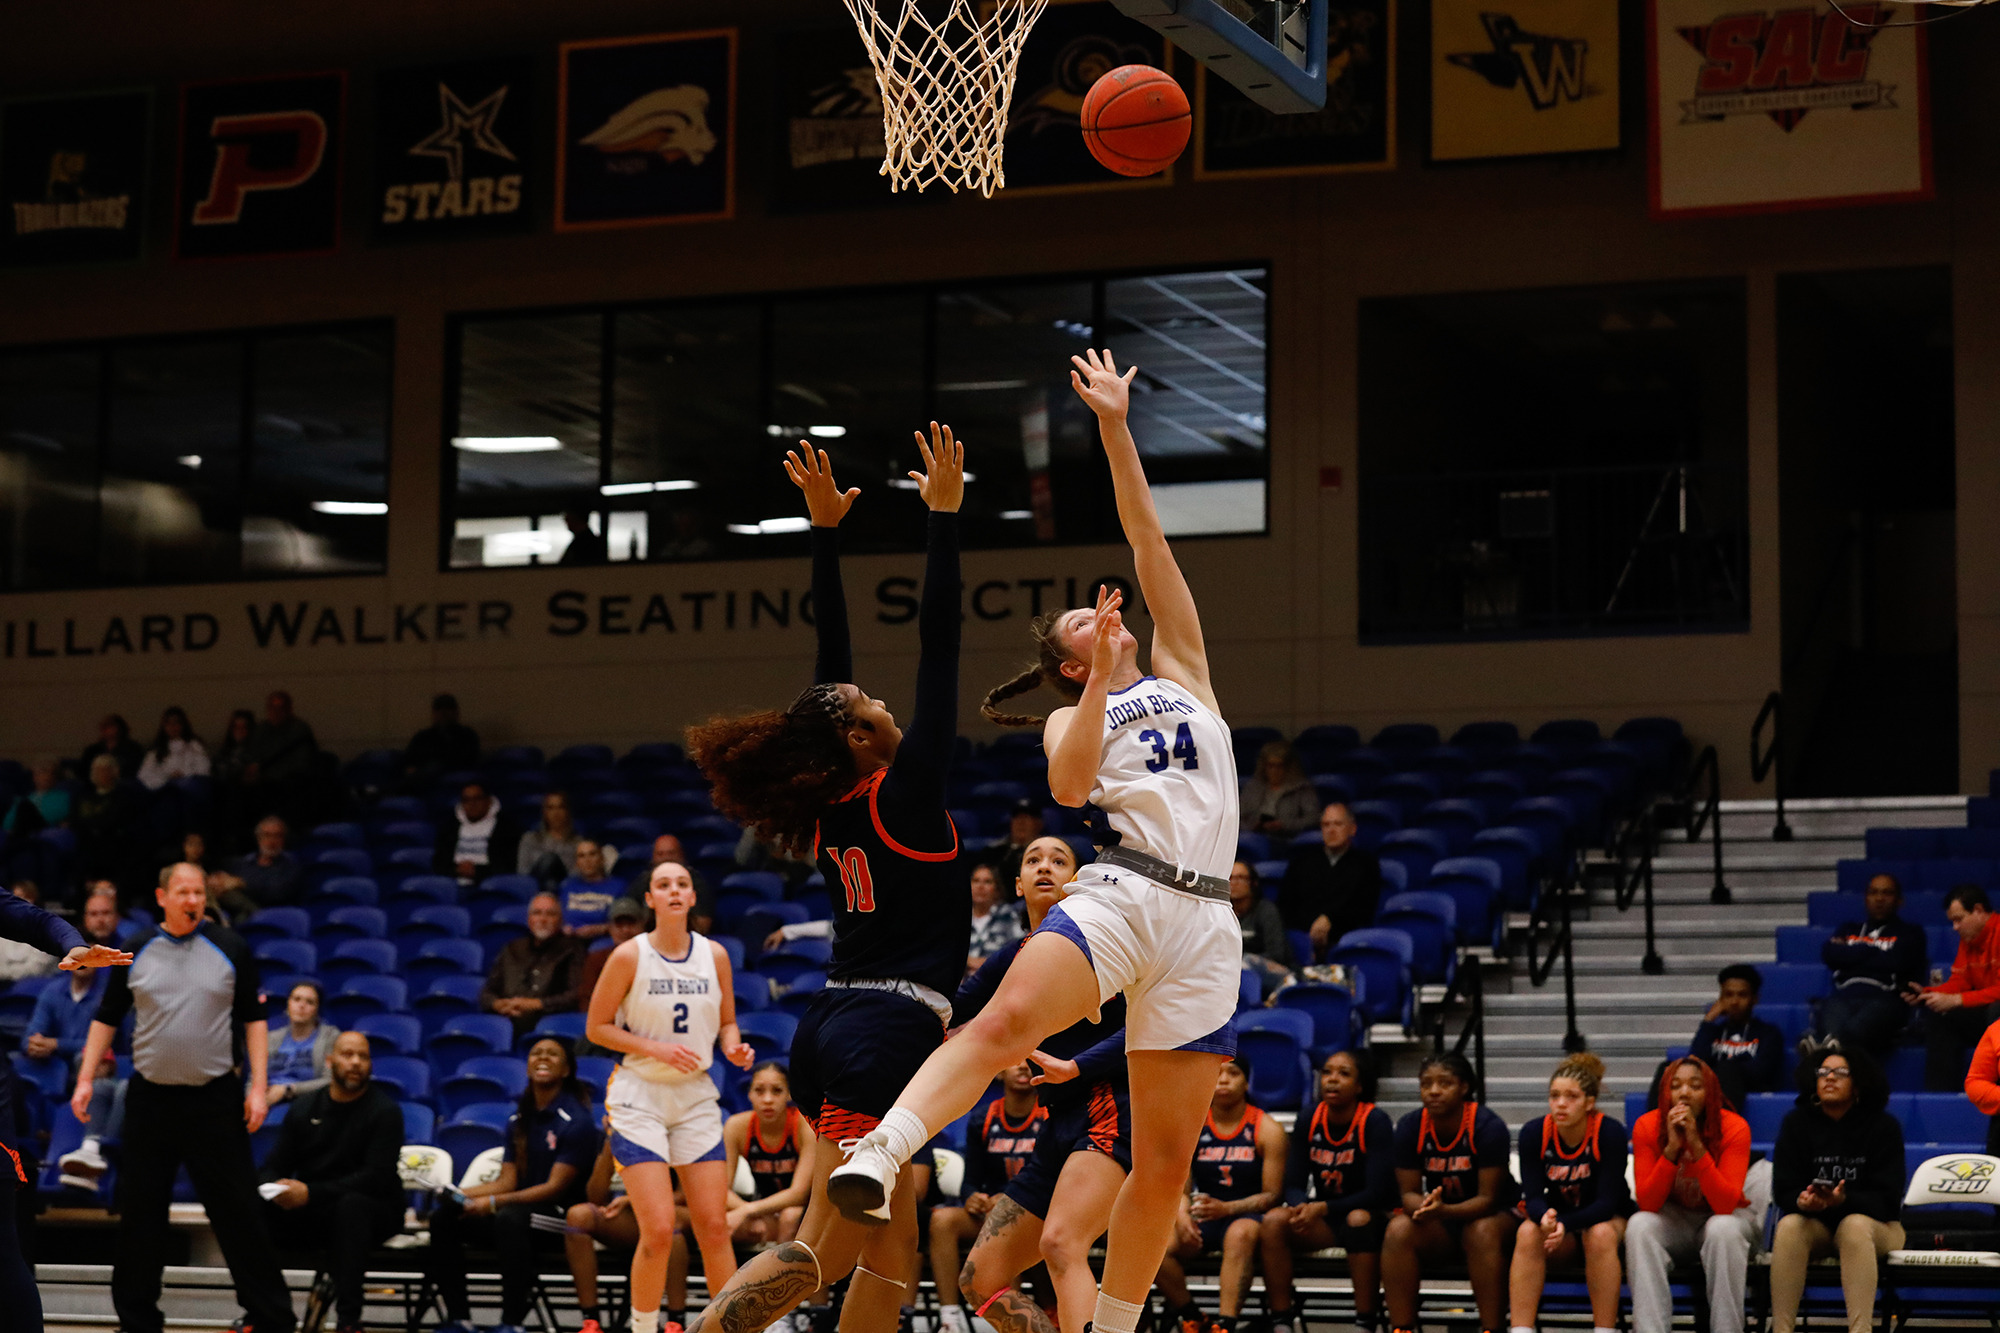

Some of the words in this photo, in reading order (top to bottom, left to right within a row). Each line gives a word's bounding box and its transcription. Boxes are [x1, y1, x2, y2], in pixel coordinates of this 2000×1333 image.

[1696, 2, 1881, 95] SAC
[1509, 38, 1590, 111] W
[192, 110, 328, 226] P
[382, 174, 523, 224] STARS
[5, 613, 220, 658] ILLARD
[247, 601, 514, 648] WALKER
[876, 576, 1150, 625] SCTIO
[1106, 697, 1149, 731] JOHN
[1146, 694, 1197, 716] BRN
[1139, 722, 1199, 774] 34
[825, 846, 876, 913] 10
[648, 978, 674, 996] JOHN
[677, 978, 709, 995] BROWN
[673, 1003, 689, 1034] 2
[1218, 1165, 1234, 1188] 3
[1928, 1179, 1991, 1194] JBU
[1904, 1254, 1941, 1265] GOLDEN
[1944, 1254, 1980, 1265] EAGLES
